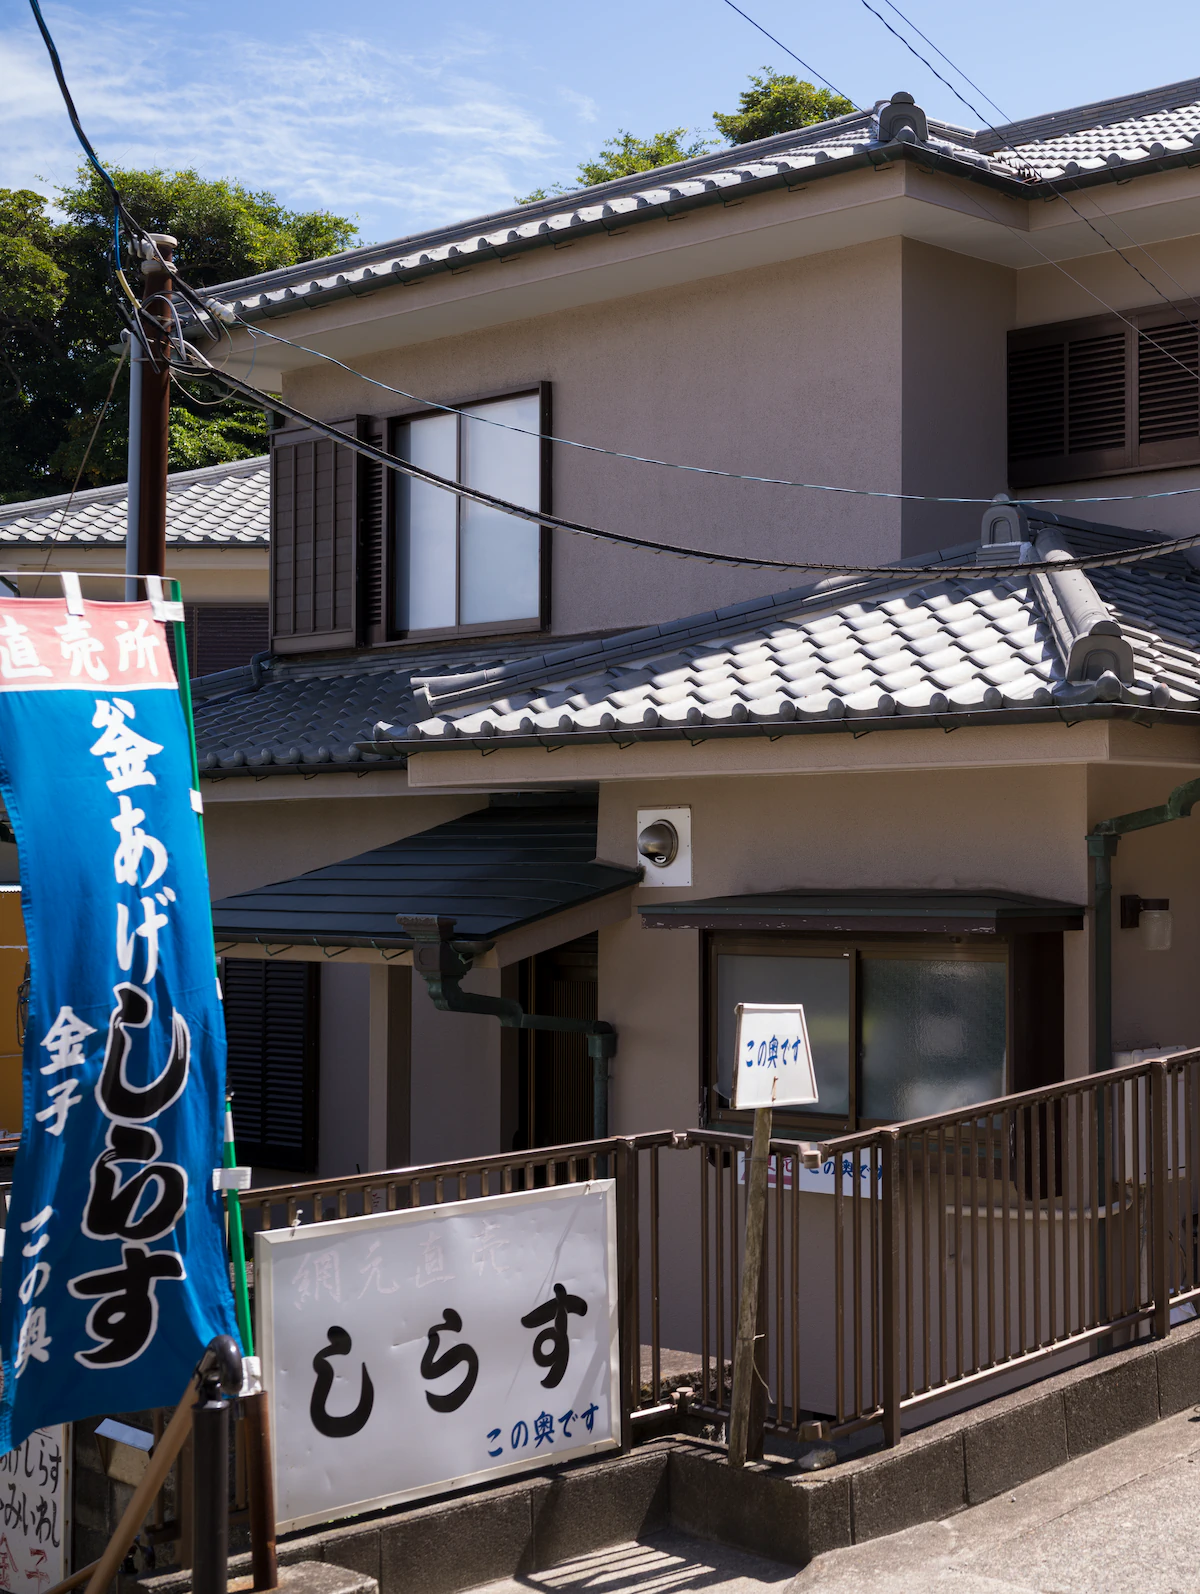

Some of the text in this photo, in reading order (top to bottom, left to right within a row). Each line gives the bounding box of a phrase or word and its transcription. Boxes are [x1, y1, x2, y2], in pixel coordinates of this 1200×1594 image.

[0, 613, 161, 681] 直売所
[67, 697, 190, 1369] 釜あげしらす
[745, 1034, 801, 1069] この奥です
[14, 1005, 97, 1379] 金子 この奥
[310, 1283, 588, 1438] しらす
[486, 1402, 600, 1458] この奥です
